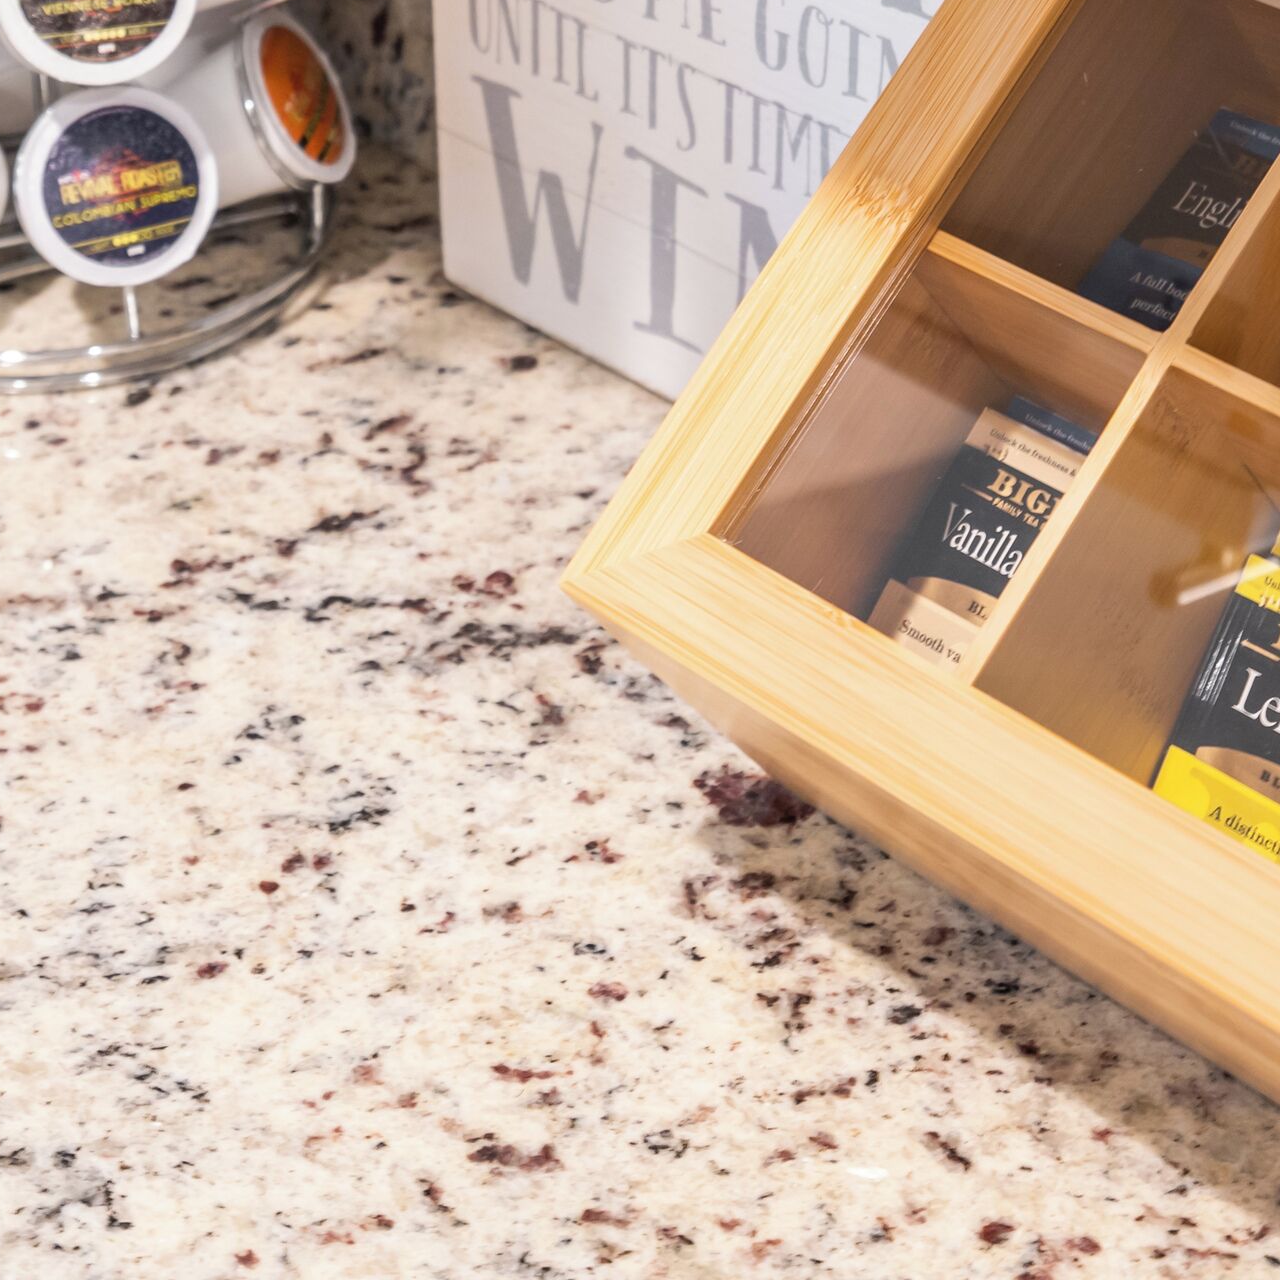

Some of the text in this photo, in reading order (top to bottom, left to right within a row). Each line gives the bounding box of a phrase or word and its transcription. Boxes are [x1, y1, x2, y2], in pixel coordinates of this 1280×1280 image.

[616, 35, 698, 152] IT'S
[52, 204, 136, 228] COLOMBIAN
[1129, 271, 1168, 291] A full
[990, 427, 1017, 446] Unlock
[1018, 443, 1031, 454] the
[1031, 449, 1069, 474] freshness
[987, 468, 1061, 518] BIG
[992, 497, 1023, 518] FAMILY
[1023, 513, 1040, 528] TEA
[942, 502, 1023, 578] Vanilla
[898, 618, 945, 655] Smooth
[1208, 805, 1222, 821] A
